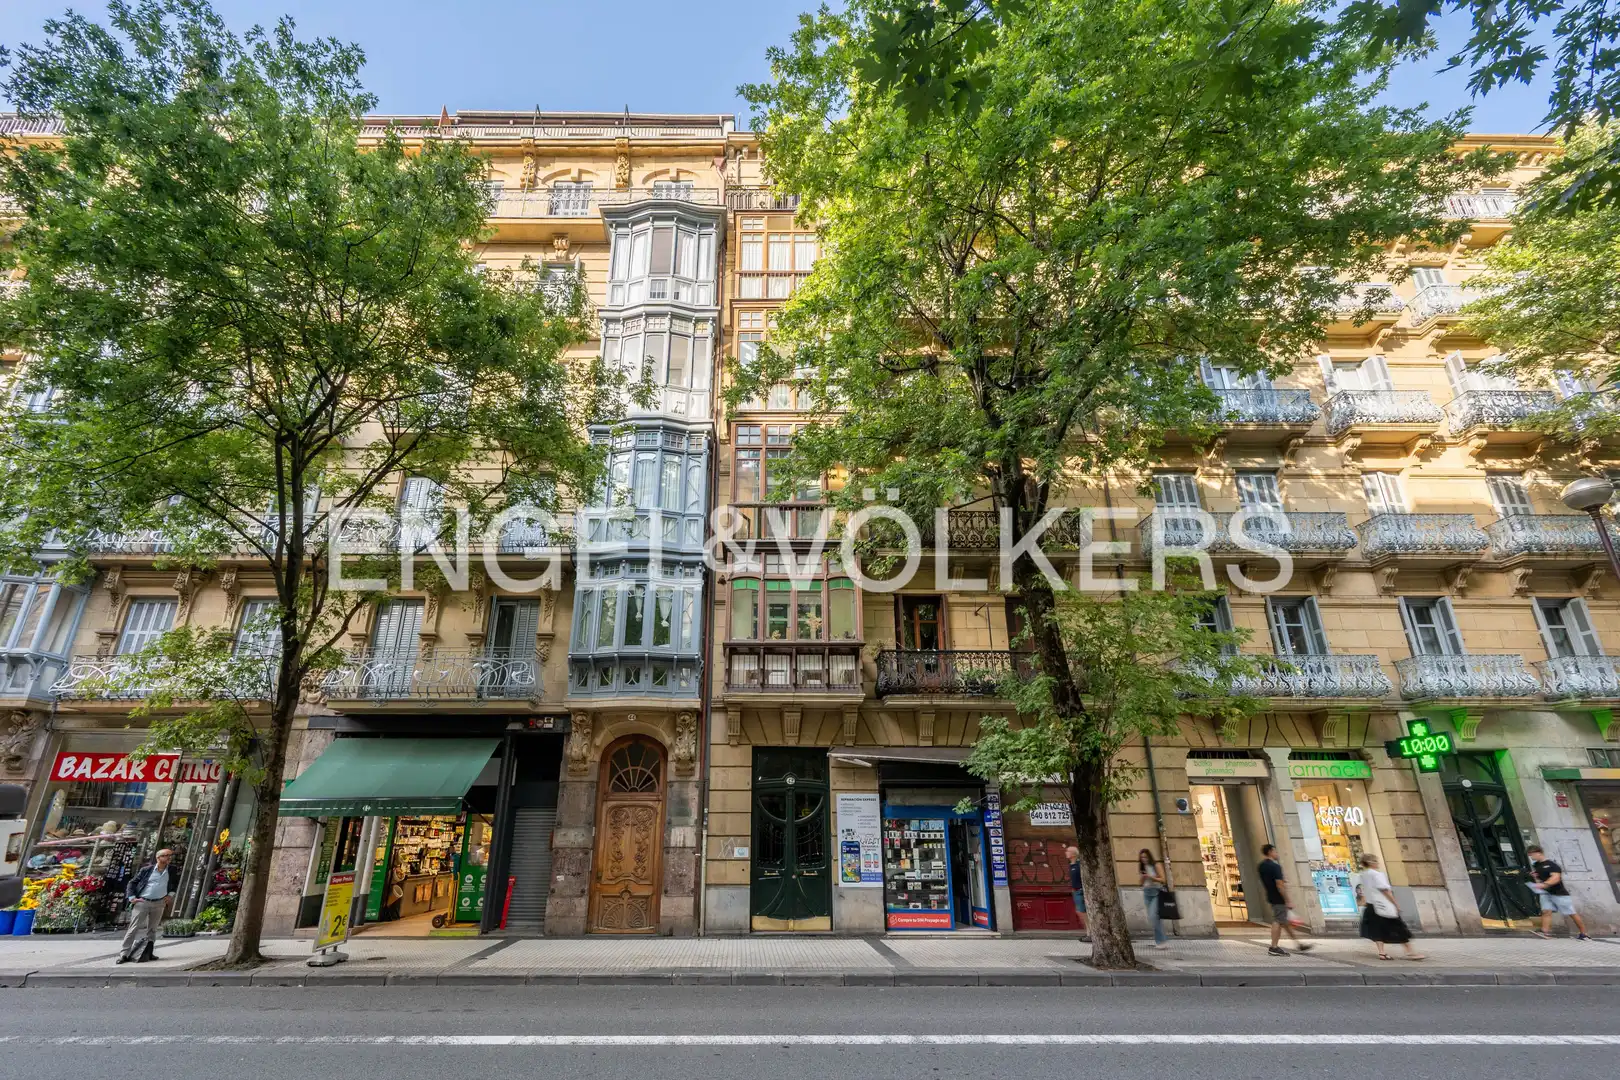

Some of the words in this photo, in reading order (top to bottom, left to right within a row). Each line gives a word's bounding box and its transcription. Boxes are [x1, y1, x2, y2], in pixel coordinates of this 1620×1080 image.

[1400, 735, 1449, 756] 10:00
[57, 756, 148, 780] BAZAR
[1205, 767, 1236, 776] pharmacy
[1344, 806, 1364, 826] 40
